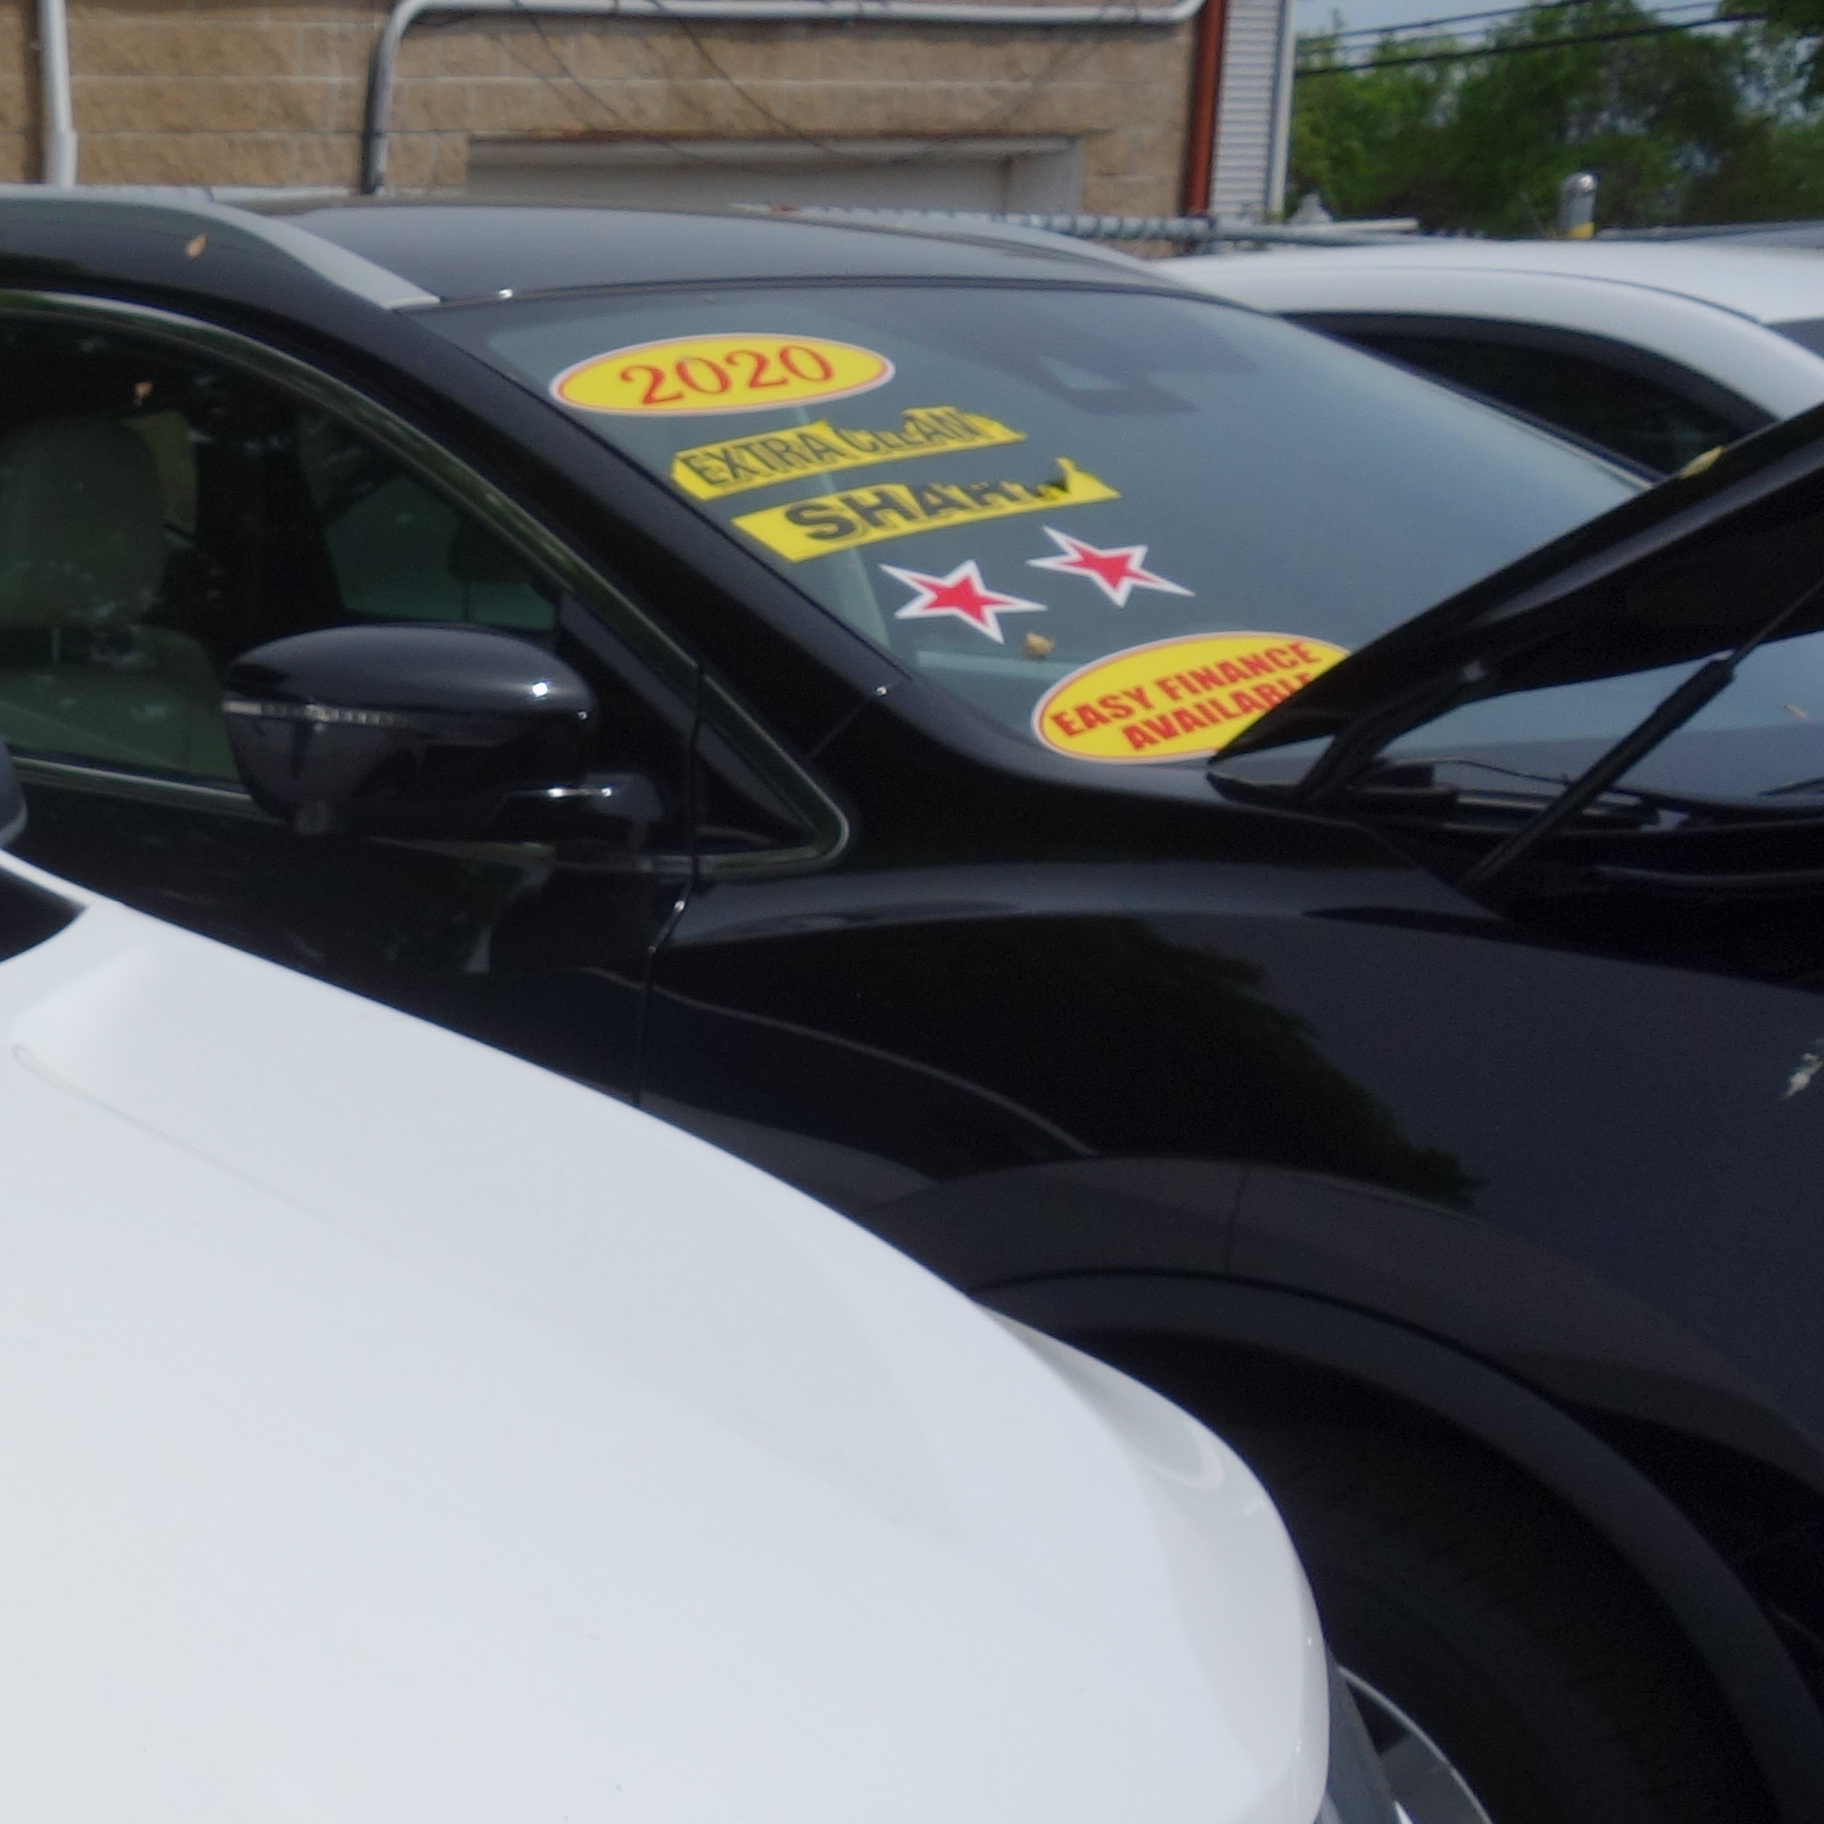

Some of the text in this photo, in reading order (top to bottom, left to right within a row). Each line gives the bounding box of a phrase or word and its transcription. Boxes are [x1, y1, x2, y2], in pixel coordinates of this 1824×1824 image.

[619, 345, 834, 407] 2020
[682, 432, 834, 486] EXTRA
[1051, 641, 1321, 737] EASY FINANCE
